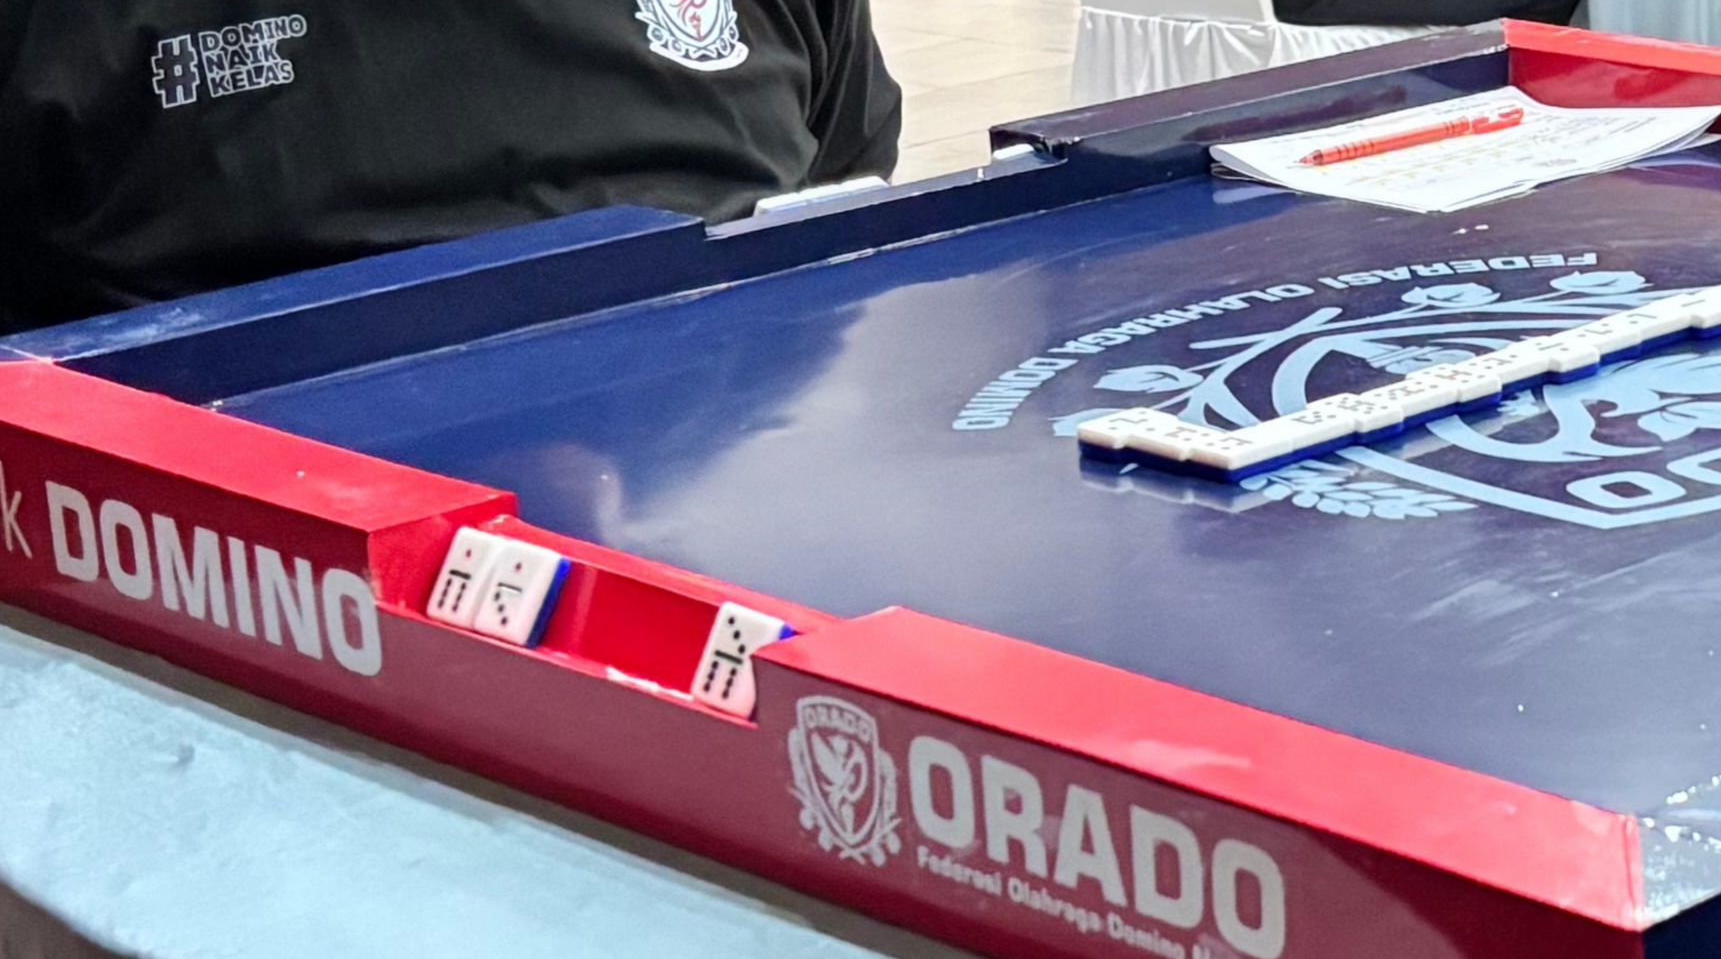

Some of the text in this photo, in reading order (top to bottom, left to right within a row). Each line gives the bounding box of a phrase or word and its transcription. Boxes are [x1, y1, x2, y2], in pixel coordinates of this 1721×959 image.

[198, 14, 307, 53] DOMINO
[202, 42, 283, 75] NAIK
[207, 59, 295, 98] KELAS
[951, 252, 1598, 430] FEDERASI OLAHRAGA DOMINO
[45, 480, 383, 677] DOMINO
[908, 735, 1286, 959] ORADO
[916, 844, 1002, 896] Federasi
[1008, 876, 1102, 934] Olahraga
